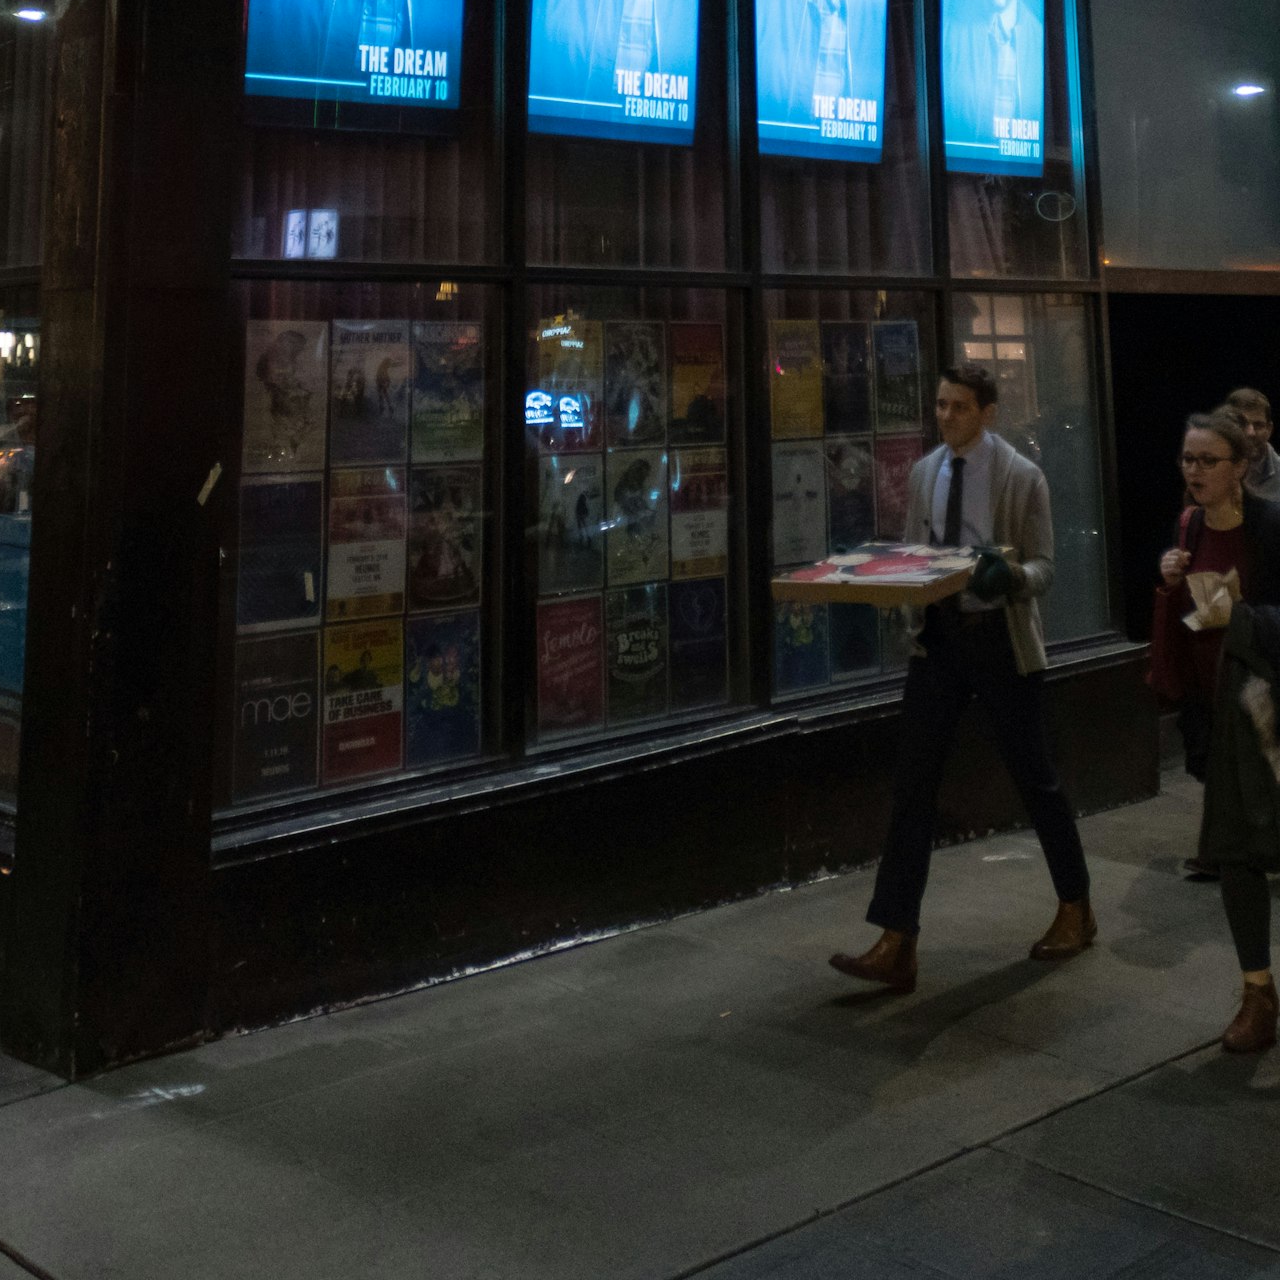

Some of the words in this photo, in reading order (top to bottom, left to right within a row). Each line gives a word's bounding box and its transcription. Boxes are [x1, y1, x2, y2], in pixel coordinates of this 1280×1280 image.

[359, 44, 391, 75] THE
[394, 48, 447, 77] DREAM
[370, 75, 431, 100] FEBRUARY
[434, 81, 447, 101] 10
[616, 69, 641, 97] THE
[644, 71, 687, 100] DREAM
[625, 97, 675, 121] FEBRUARY
[677, 102, 687, 122] 10
[814, 95, 835, 119] THE
[838, 98, 876, 122] DREAM
[821, 122, 866, 141] FEBRUARY
[868, 126, 877, 142] 10
[994, 117, 1010, 138] THE
[1012, 119, 1039, 139] DREAM
[1000, 138, 1031, 156] FEBRUARY
[1033, 141, 1039, 157] 10
[241, 691, 312, 727] mae
[328, 708, 342, 721] OF
[342, 700, 394, 719] BUSINESS
[329, 694, 355, 708] TAKE
[356, 691, 383, 705] CARE
